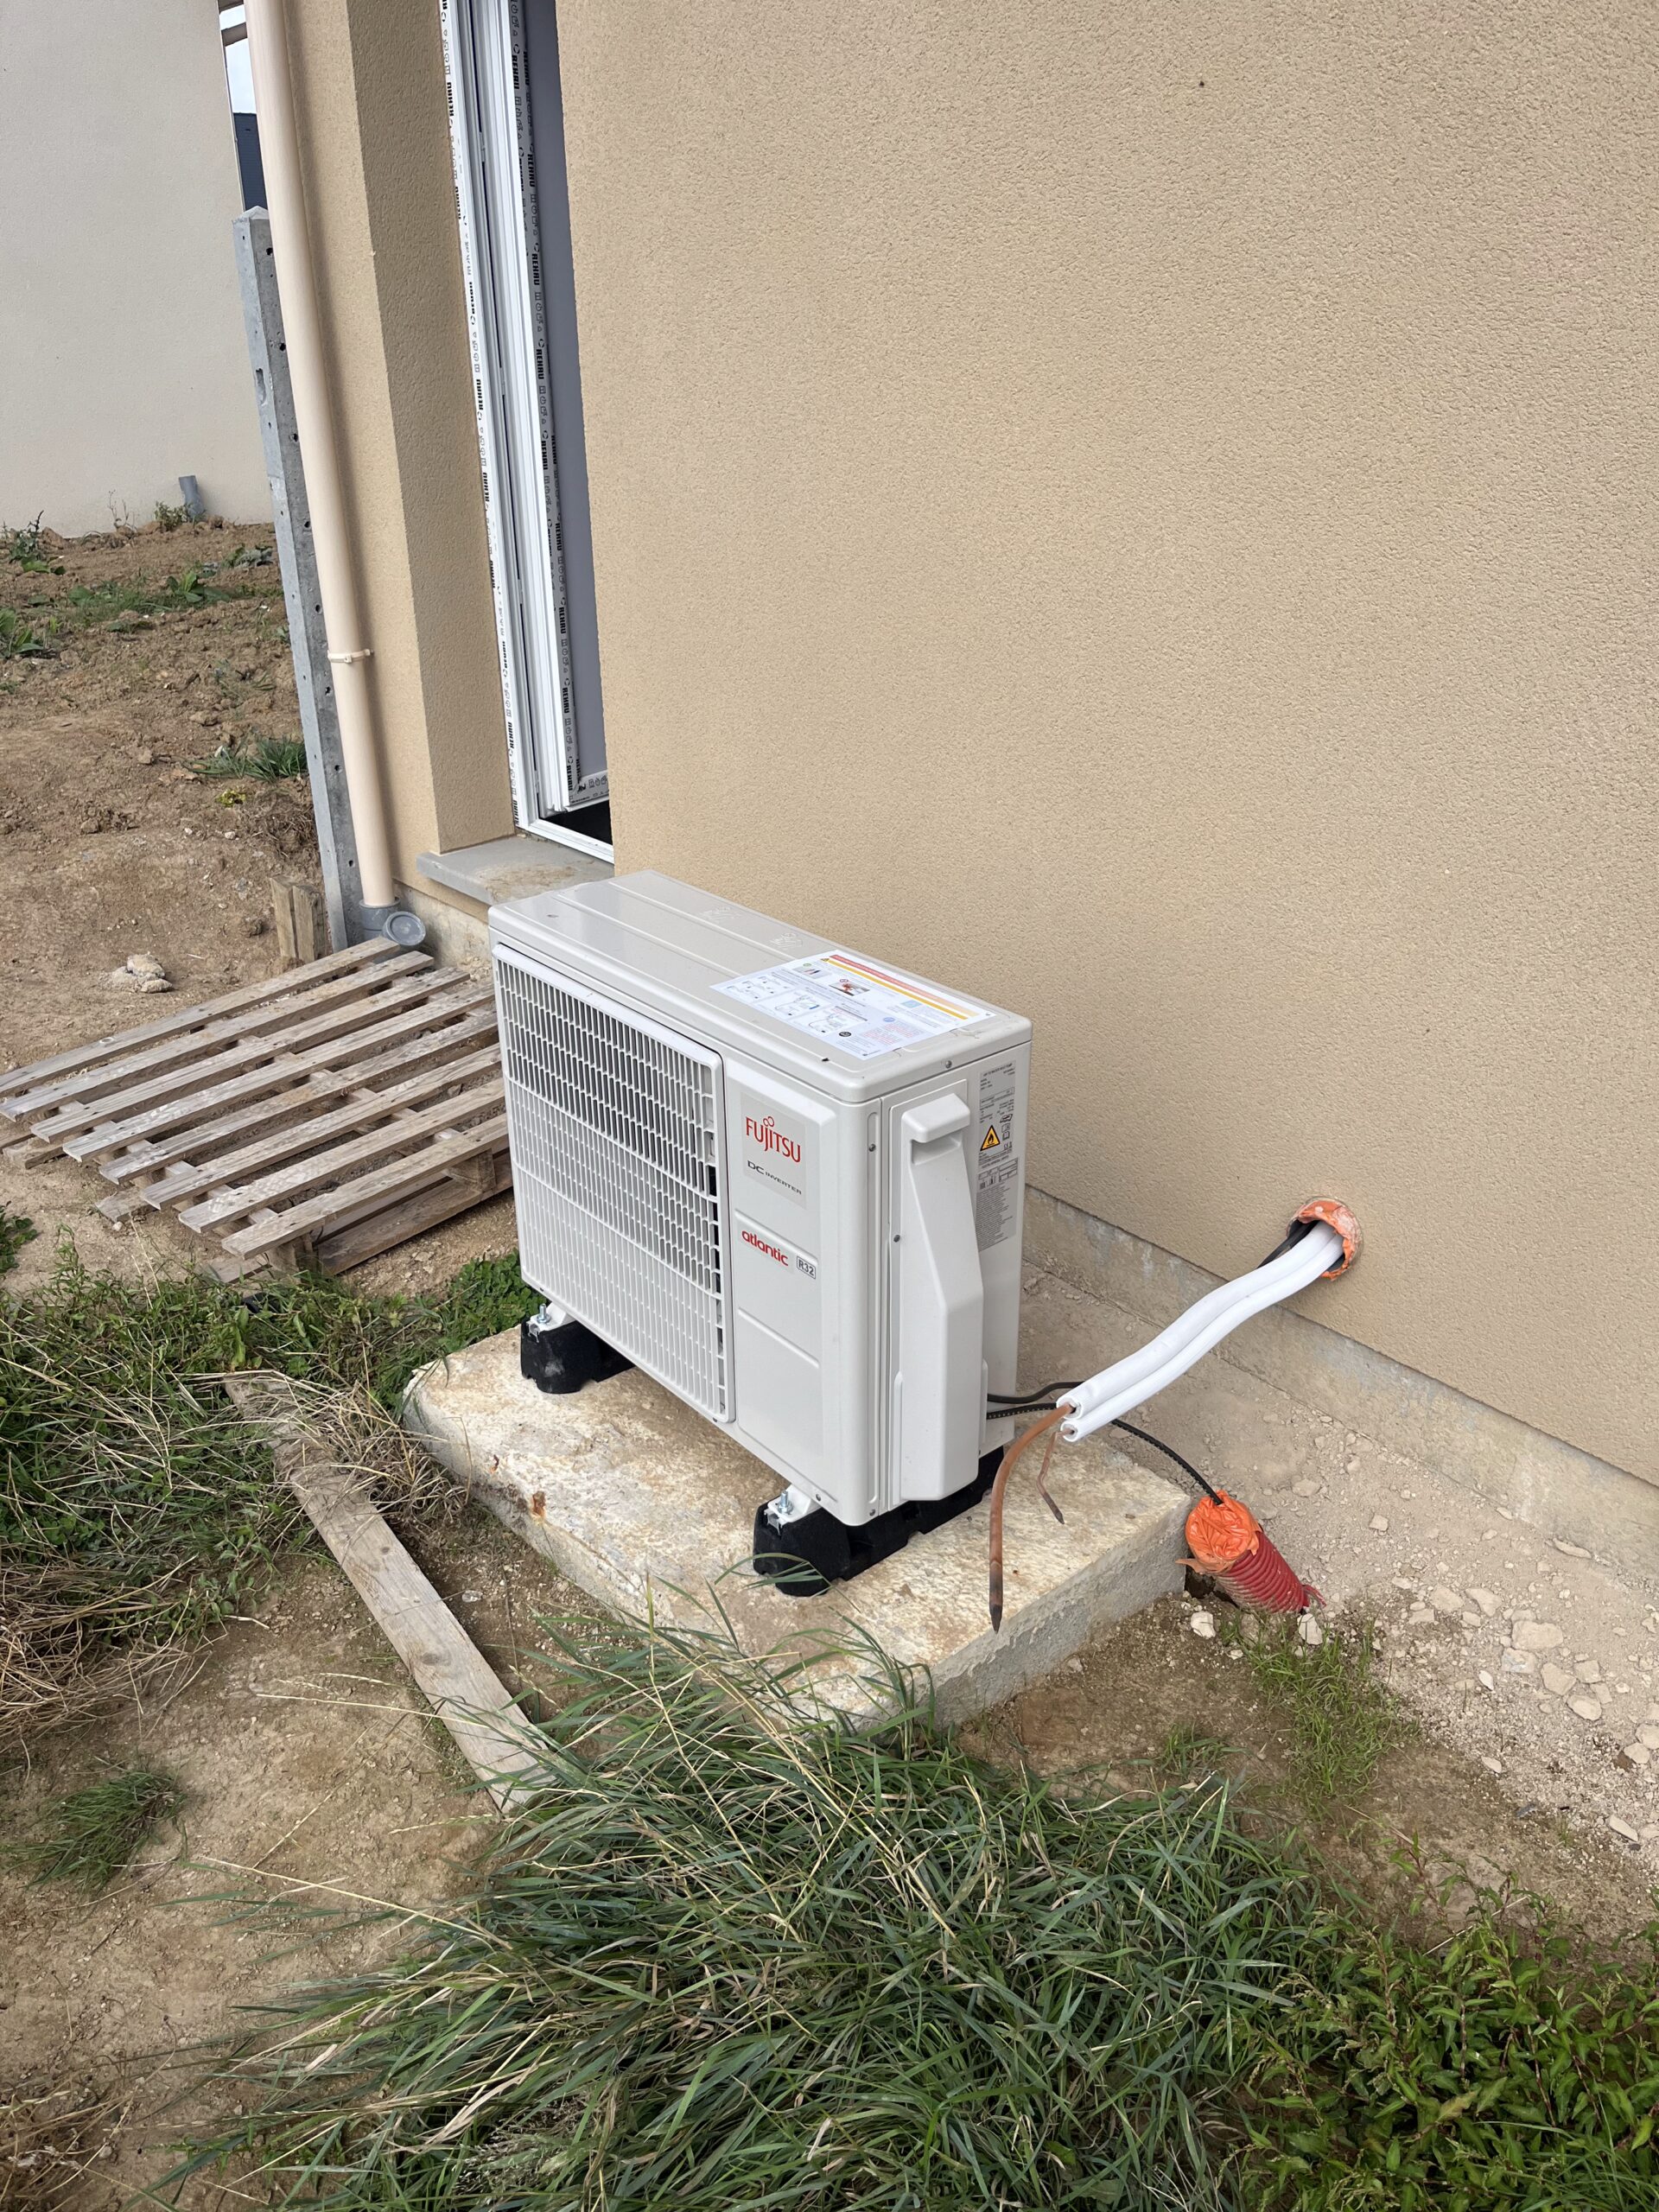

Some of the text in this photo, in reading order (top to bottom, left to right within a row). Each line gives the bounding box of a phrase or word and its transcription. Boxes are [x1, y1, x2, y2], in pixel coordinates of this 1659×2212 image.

[512, 55, 520, 90] REHAU
[527, 154, 536, 187] REHAU
[536, 349, 544, 379] REHAU
[558, 607, 567, 634] REHAU
[746, 1116, 801, 1163] FUJITSU
[747, 1160, 802, 1195] DC INVERTER
[741, 1230, 788, 1267] atlantic
[798, 1259, 815, 1277] R32
